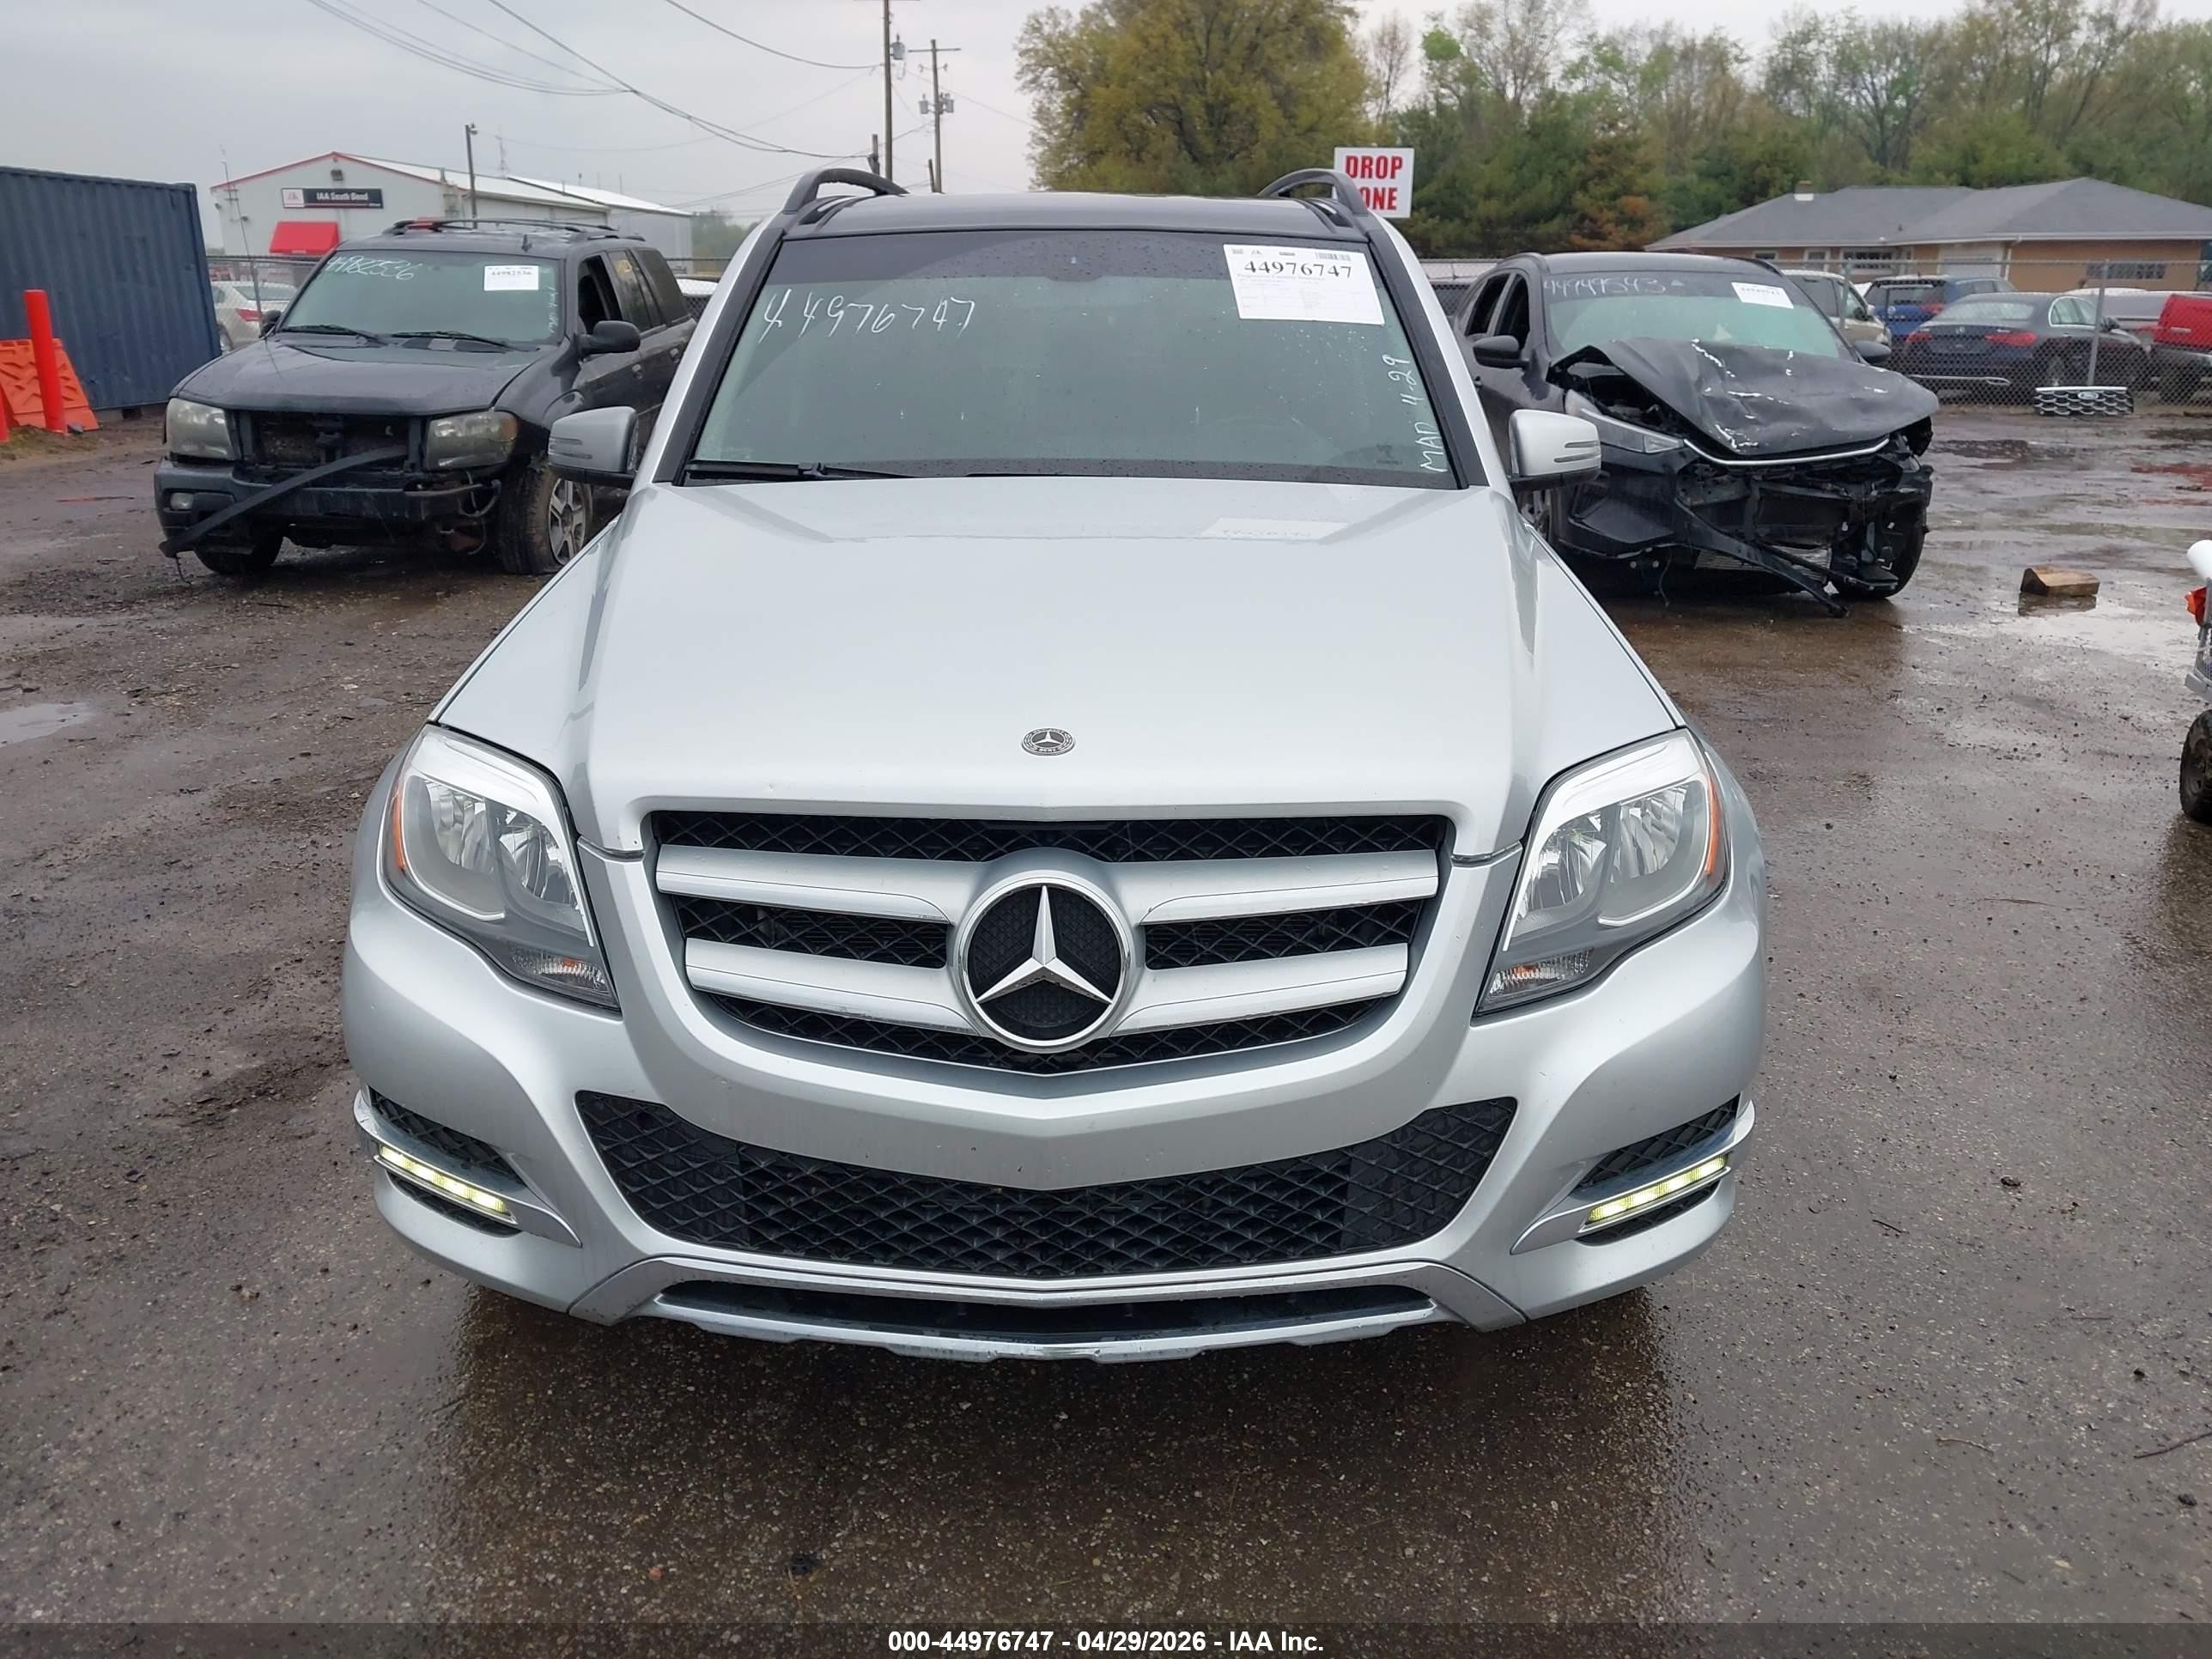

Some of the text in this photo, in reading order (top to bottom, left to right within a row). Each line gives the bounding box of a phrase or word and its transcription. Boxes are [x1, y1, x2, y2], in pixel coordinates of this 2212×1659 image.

[1346, 155, 1403, 179] DROP
[1359, 186, 1398, 210] ONE
[1244, 260, 1352, 279] 44976747
[1382, 354, 1448, 472] MAD 4-29
